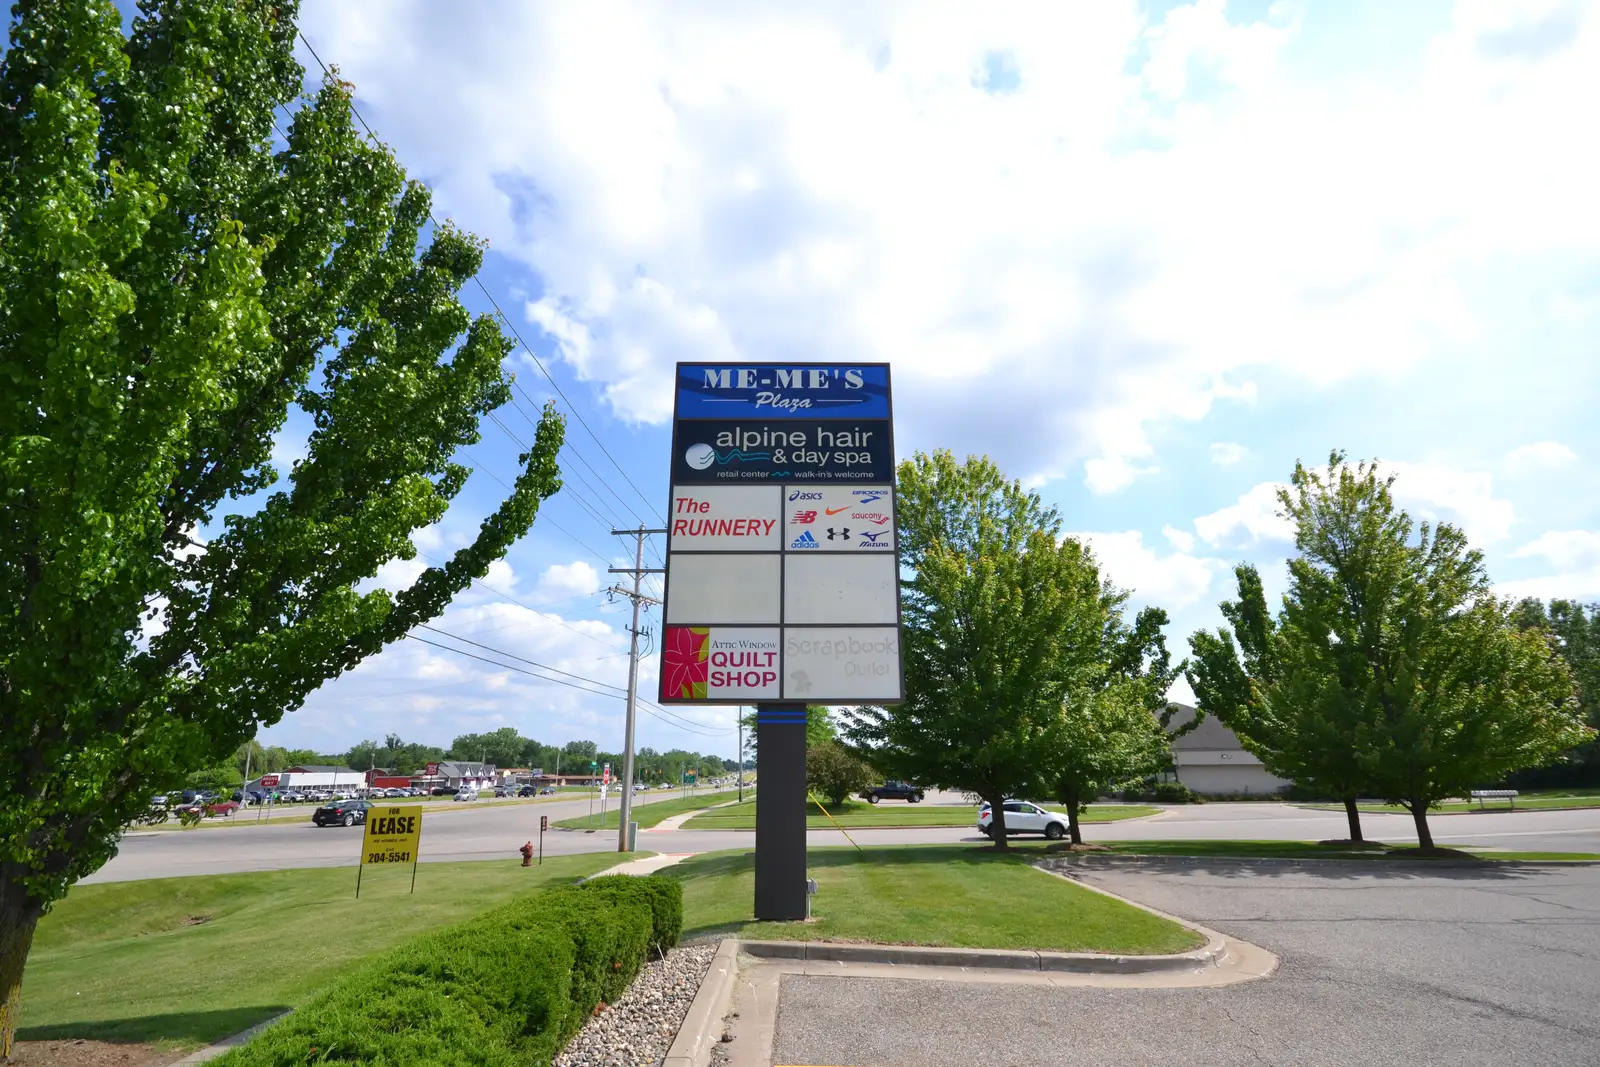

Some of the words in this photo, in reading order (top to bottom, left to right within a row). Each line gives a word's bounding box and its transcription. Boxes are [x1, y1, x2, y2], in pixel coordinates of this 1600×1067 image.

[702, 369, 864, 389] ME-ME'S
[755, 391, 812, 412] Plaza
[716, 427, 807, 451] alpine
[817, 427, 873, 447] hair
[772, 449, 788, 464] &
[792, 449, 828, 466] day
[834, 451, 872, 467] spa
[717, 470, 739, 478] retail
[794, 470, 832, 478] walk-in's
[834, 470, 874, 478] welcome
[676, 498, 710, 513] The
[672, 519, 776, 536] RUNNERY
[786, 636, 898, 659] Scrapbook
[711, 651, 777, 668] QUILT
[844, 662, 890, 676] Outlet
[710, 671, 777, 687] SHOP
[370, 816, 416, 835] LEASE
[368, 852, 410, 864] 204-5541
